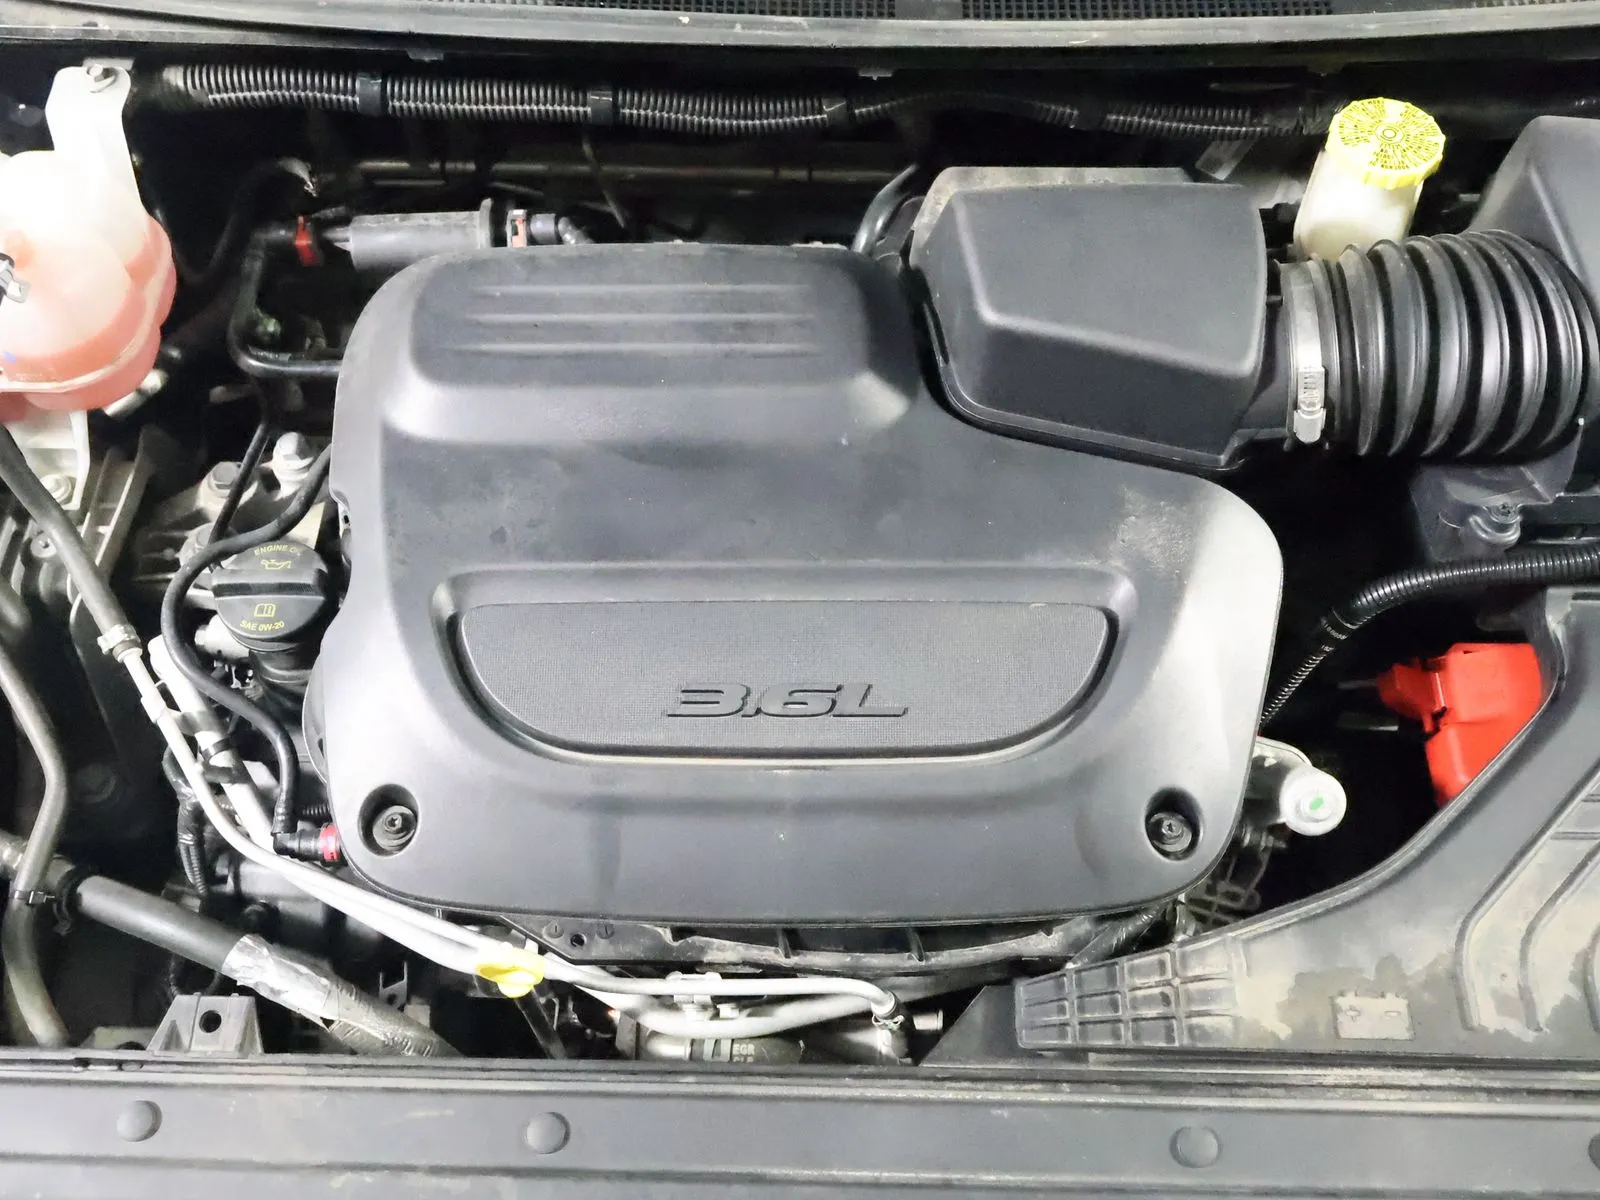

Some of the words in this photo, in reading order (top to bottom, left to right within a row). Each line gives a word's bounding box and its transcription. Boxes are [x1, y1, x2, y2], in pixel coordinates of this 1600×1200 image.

[254, 544, 288, 556] ENGINE
[240, 619, 258, 631] SAE
[258, 620, 285, 632] 0W-20
[665, 682, 909, 718] 3.6L
[733, 1043, 755, 1056] EGR
